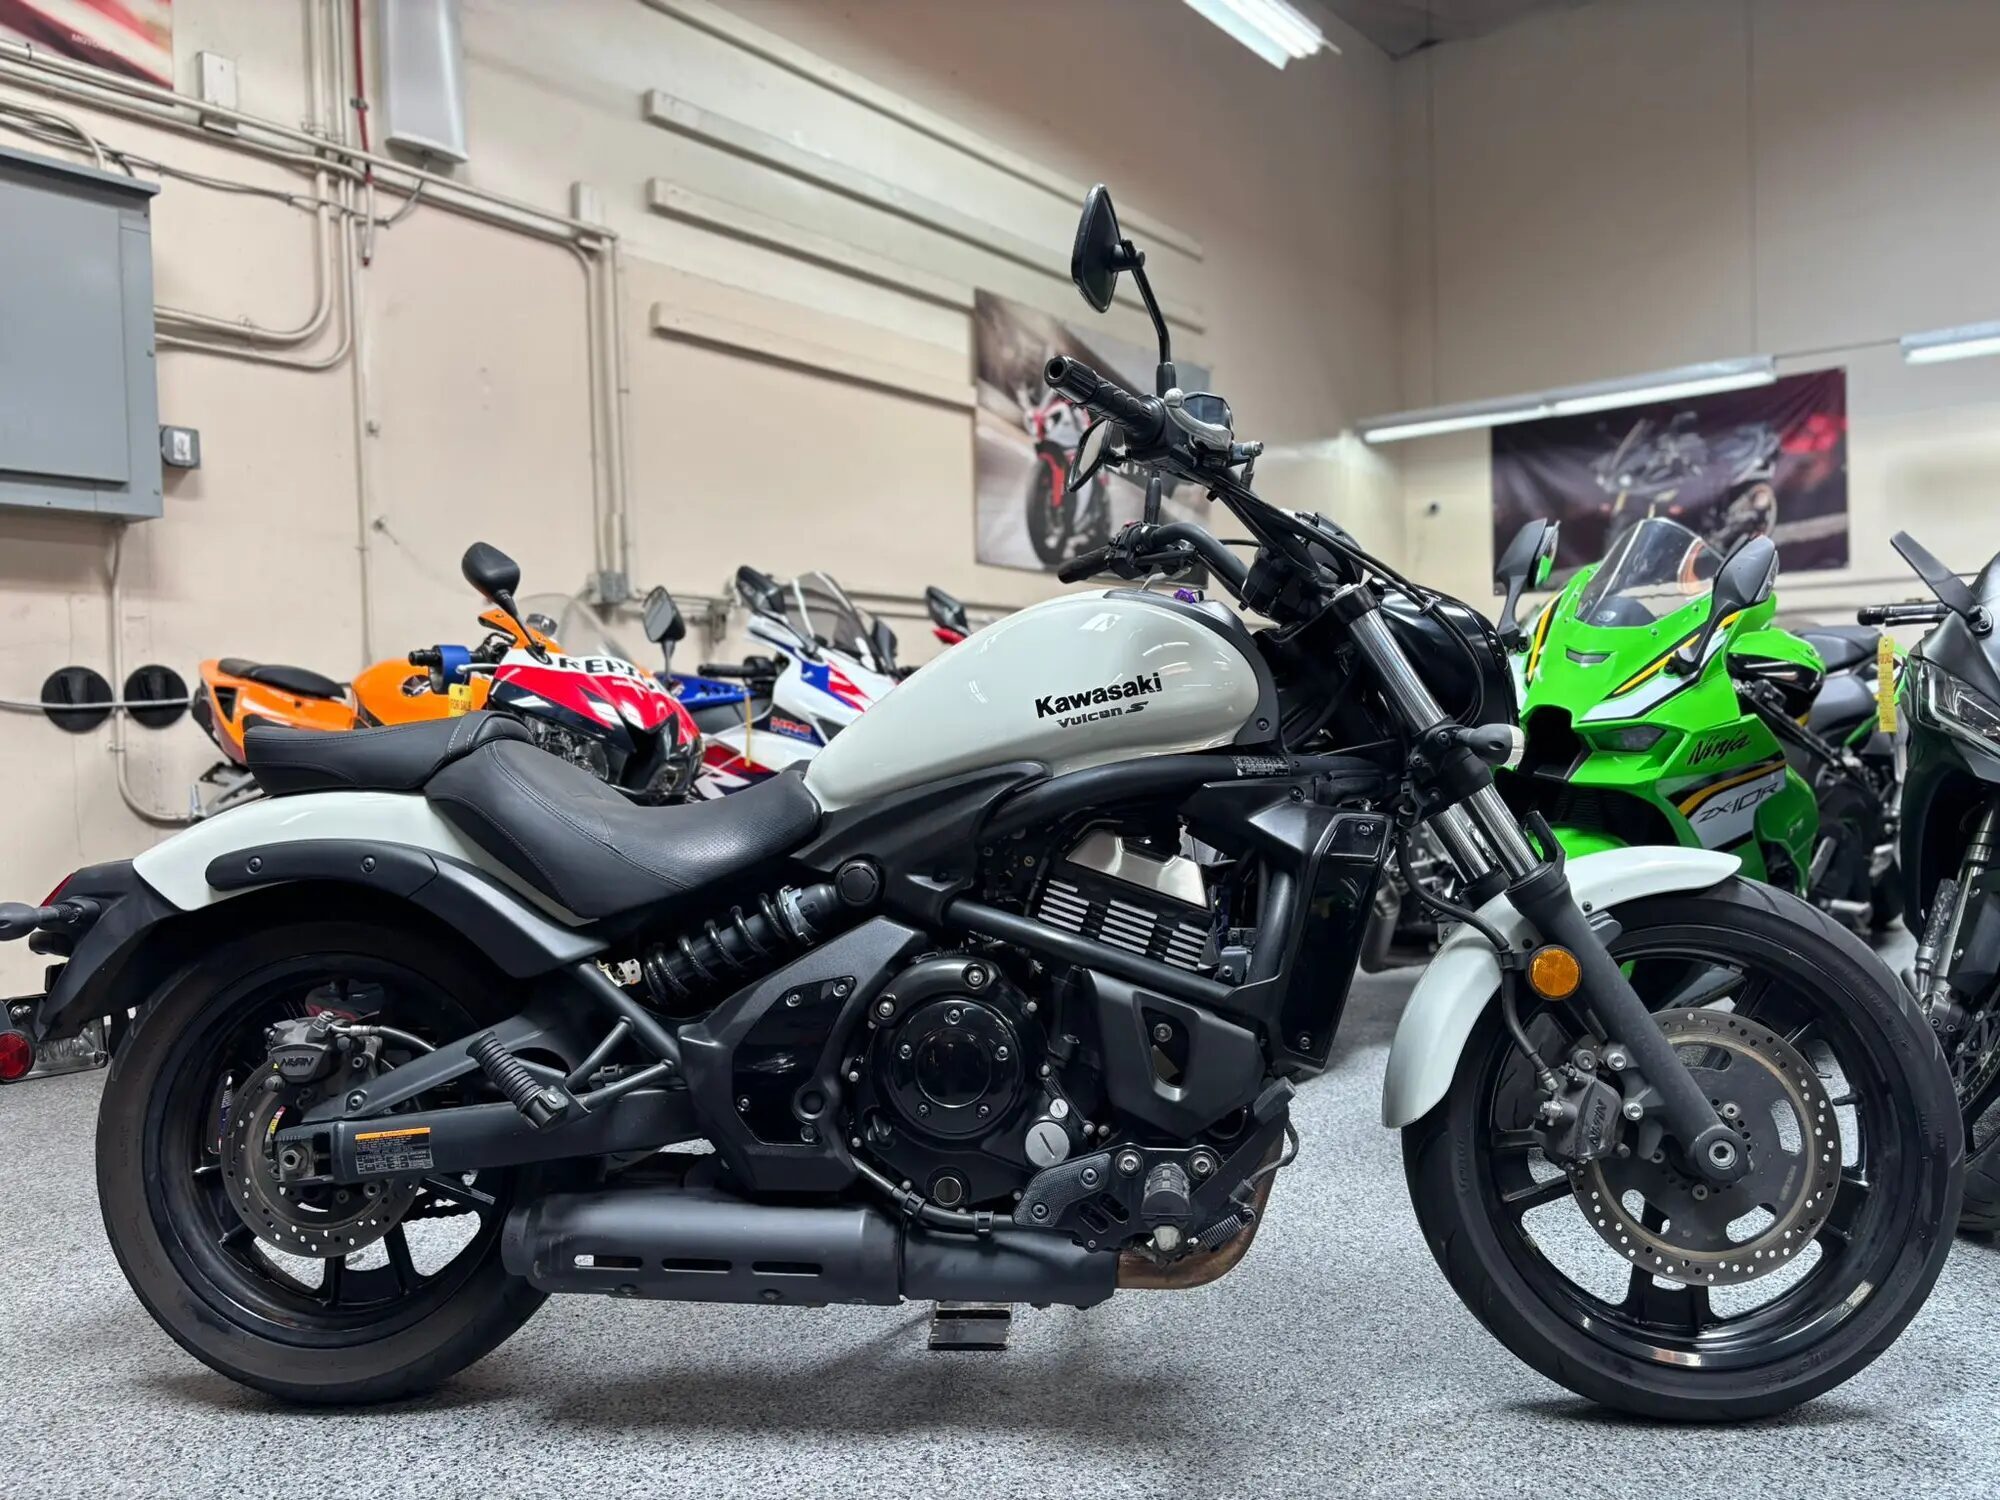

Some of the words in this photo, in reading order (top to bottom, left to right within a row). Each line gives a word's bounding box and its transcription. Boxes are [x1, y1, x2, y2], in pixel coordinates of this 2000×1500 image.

[1035, 672, 1163, 719] Kawasaki
[1057, 706, 1123, 728] Vulcan
[1125, 700, 1150, 714] S
[1686, 729, 1752, 767] Ninja
[1697, 781, 1780, 824] ZX-10R
